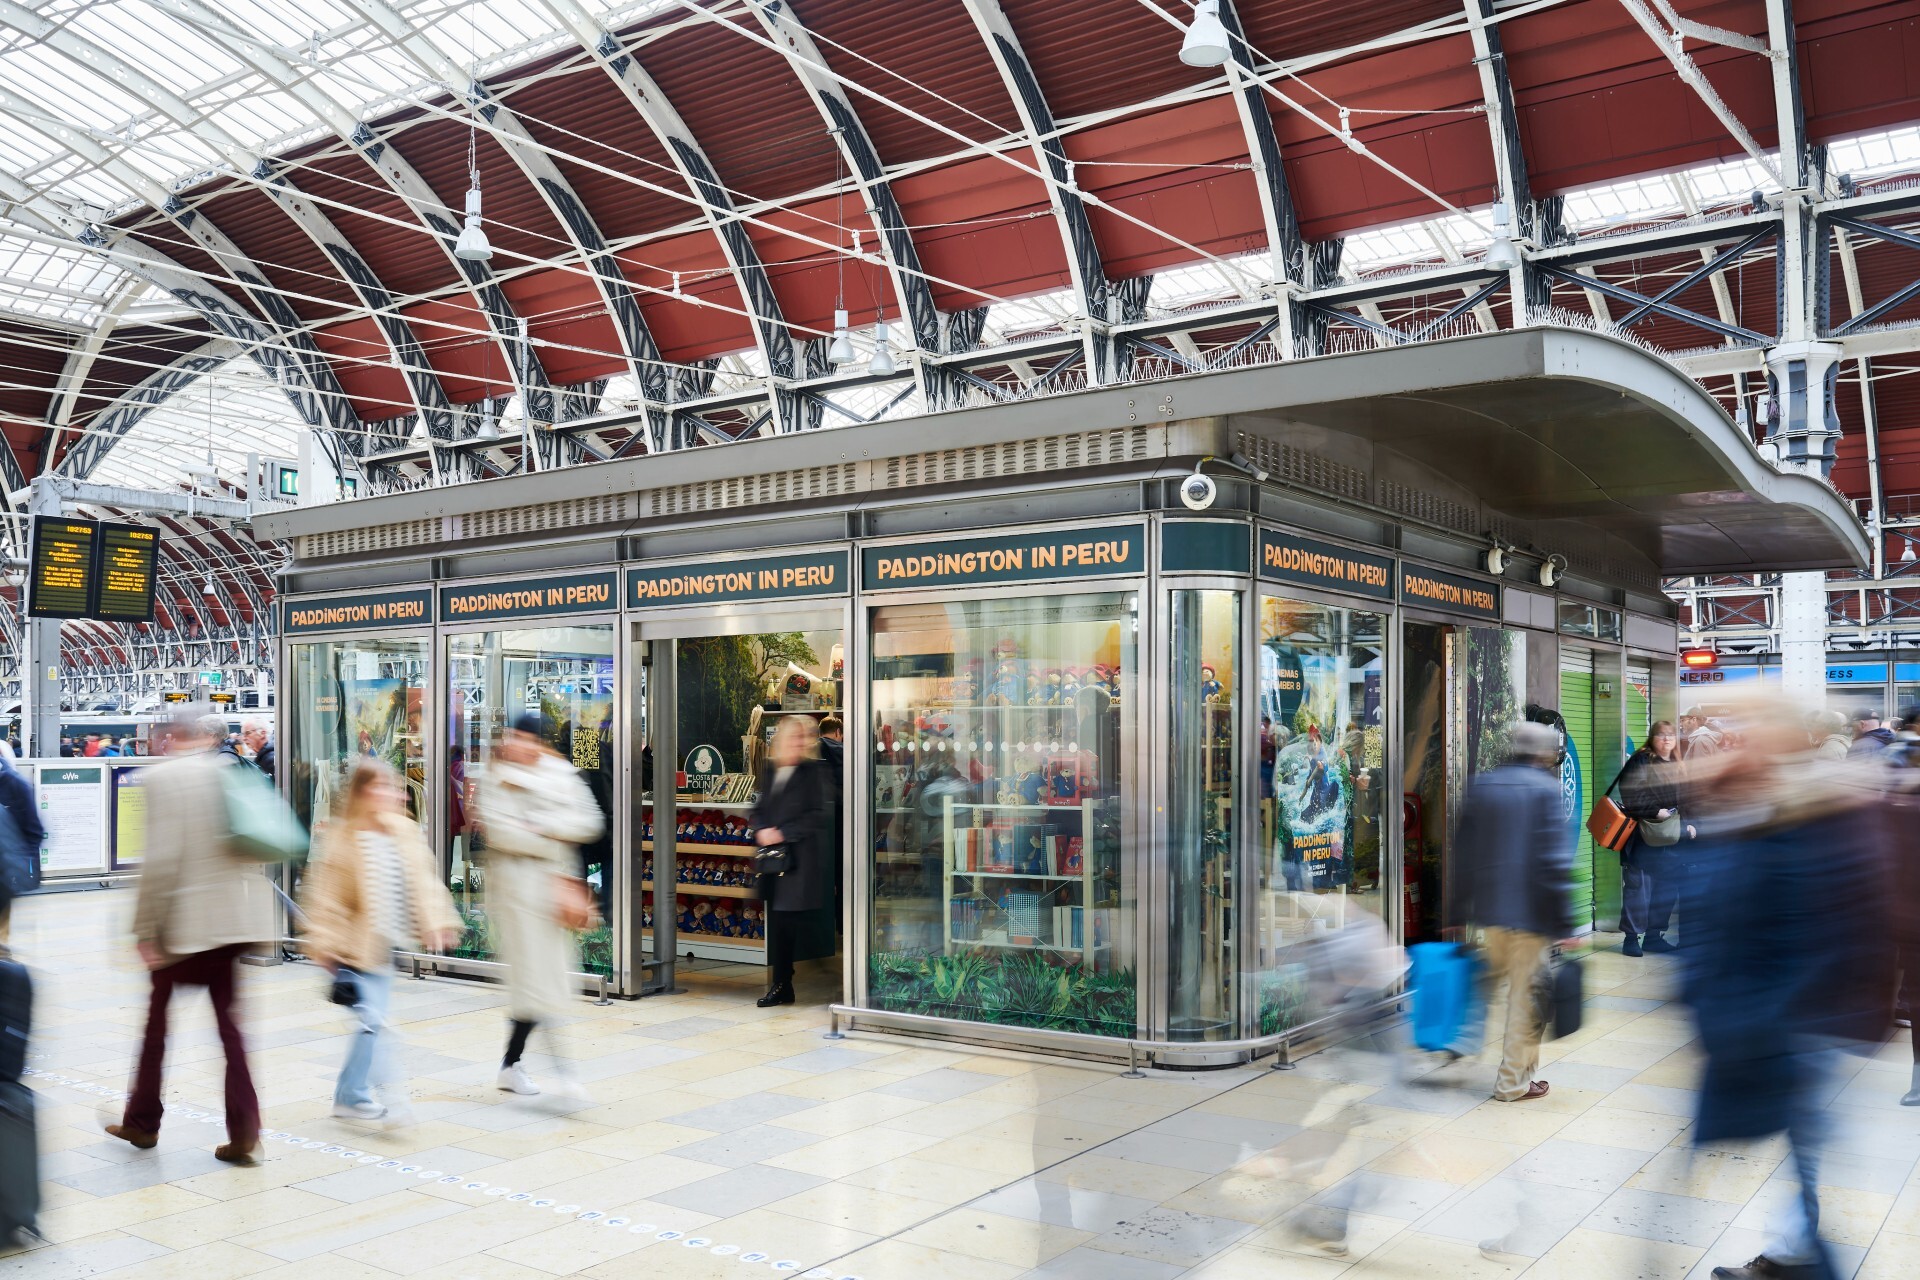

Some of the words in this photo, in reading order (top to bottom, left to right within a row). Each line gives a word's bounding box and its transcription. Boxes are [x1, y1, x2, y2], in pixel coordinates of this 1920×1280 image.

[1032, 547, 1055, 568] IN
[1062, 541, 1129, 566] PERU
[759, 570, 778, 589] IN
[783, 565, 834, 588] PERU
[1347, 561, 1358, 581] IN
[1360, 564, 1387, 587] PERU
[548, 588, 563, 605] IN
[566, 584, 609, 604] PERU
[1463, 590, 1471, 604] IN
[1473, 591, 1494, 610] PERU
[373, 604, 386, 619] IN
[389, 601, 424, 618] PERU
[1296, 682, 1301, 691] 8
[62, 772, 79, 781] GWR
[1303, 850, 1311, 861] IN
[1312, 847, 1331, 861] PERU
